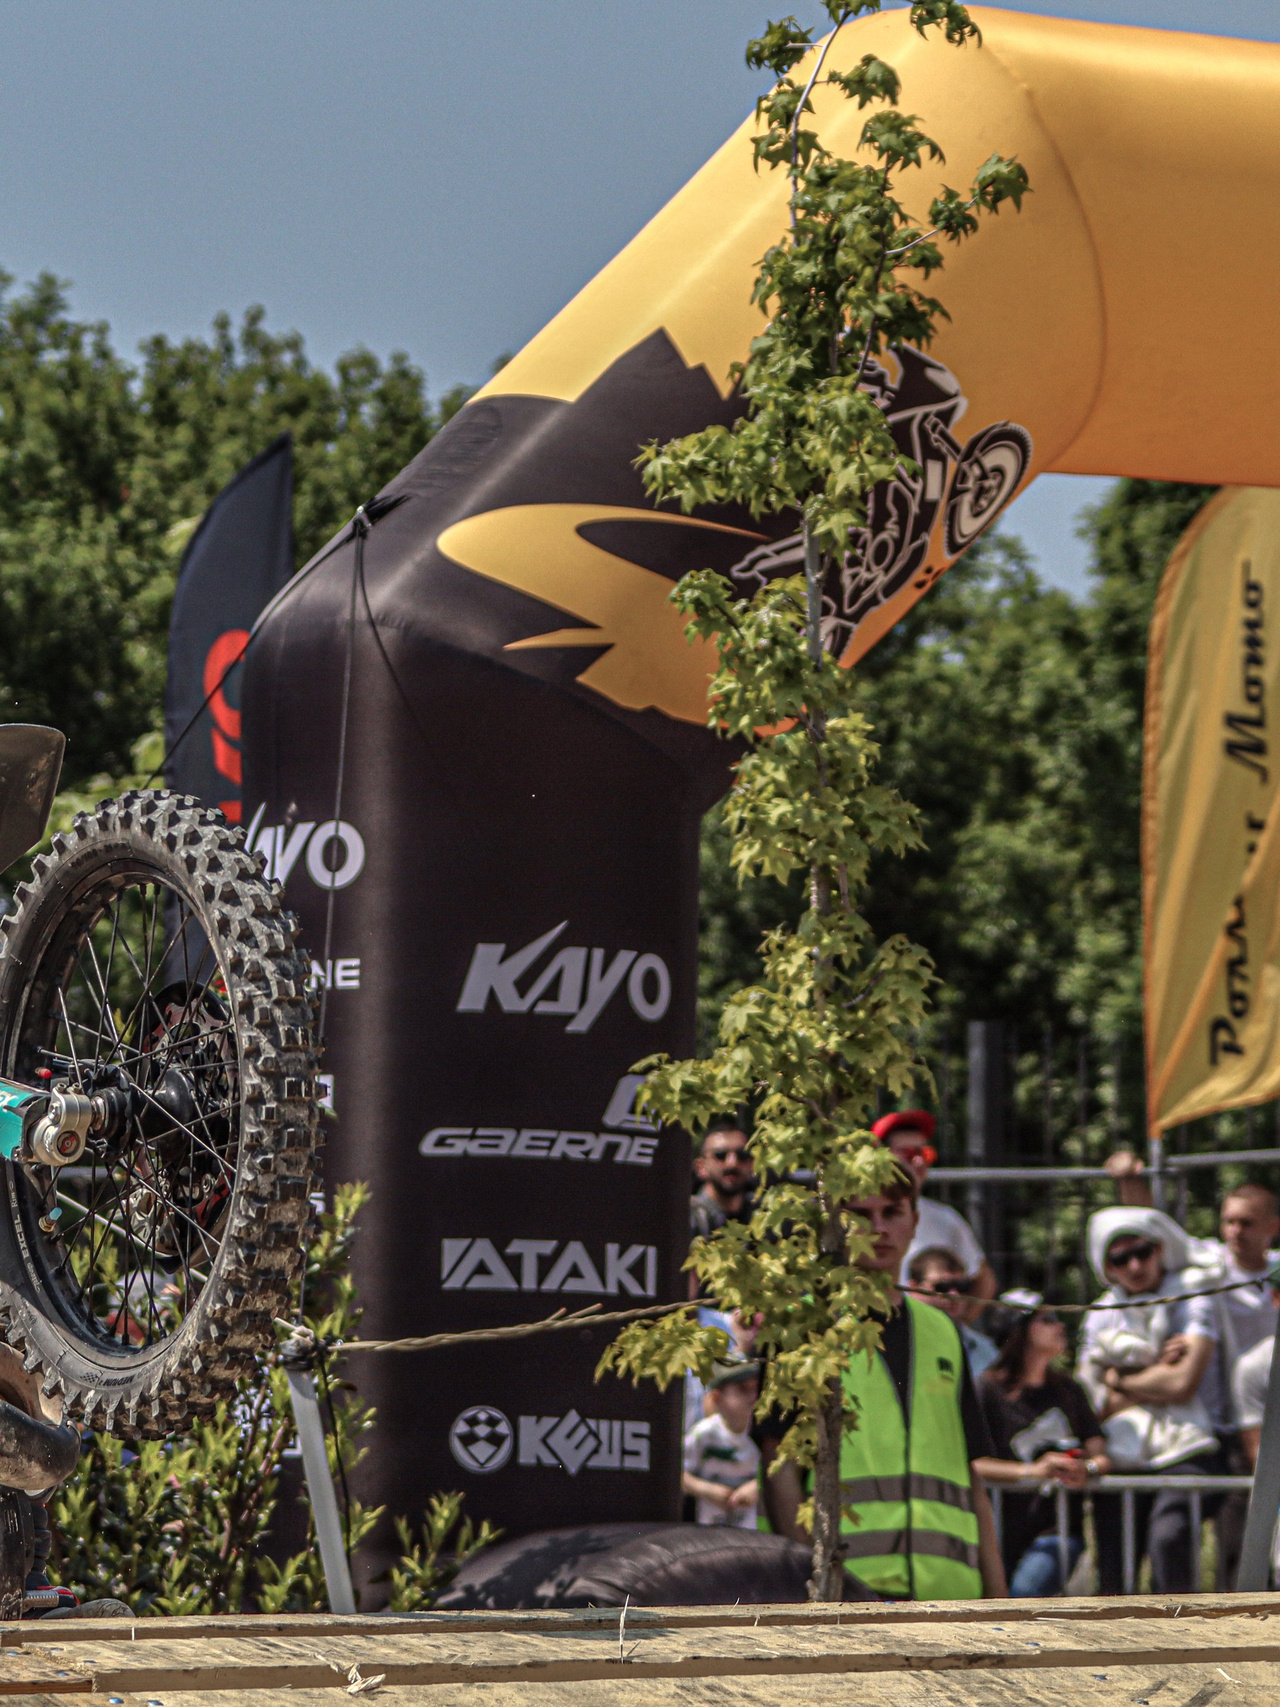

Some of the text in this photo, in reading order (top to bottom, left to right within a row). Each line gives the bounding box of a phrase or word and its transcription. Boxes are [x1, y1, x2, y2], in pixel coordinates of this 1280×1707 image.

[456, 920, 672, 1035] KAYO
[14, 1214, 29, 1259] EXCEL
[441, 1237, 657, 1297] ATAKI
